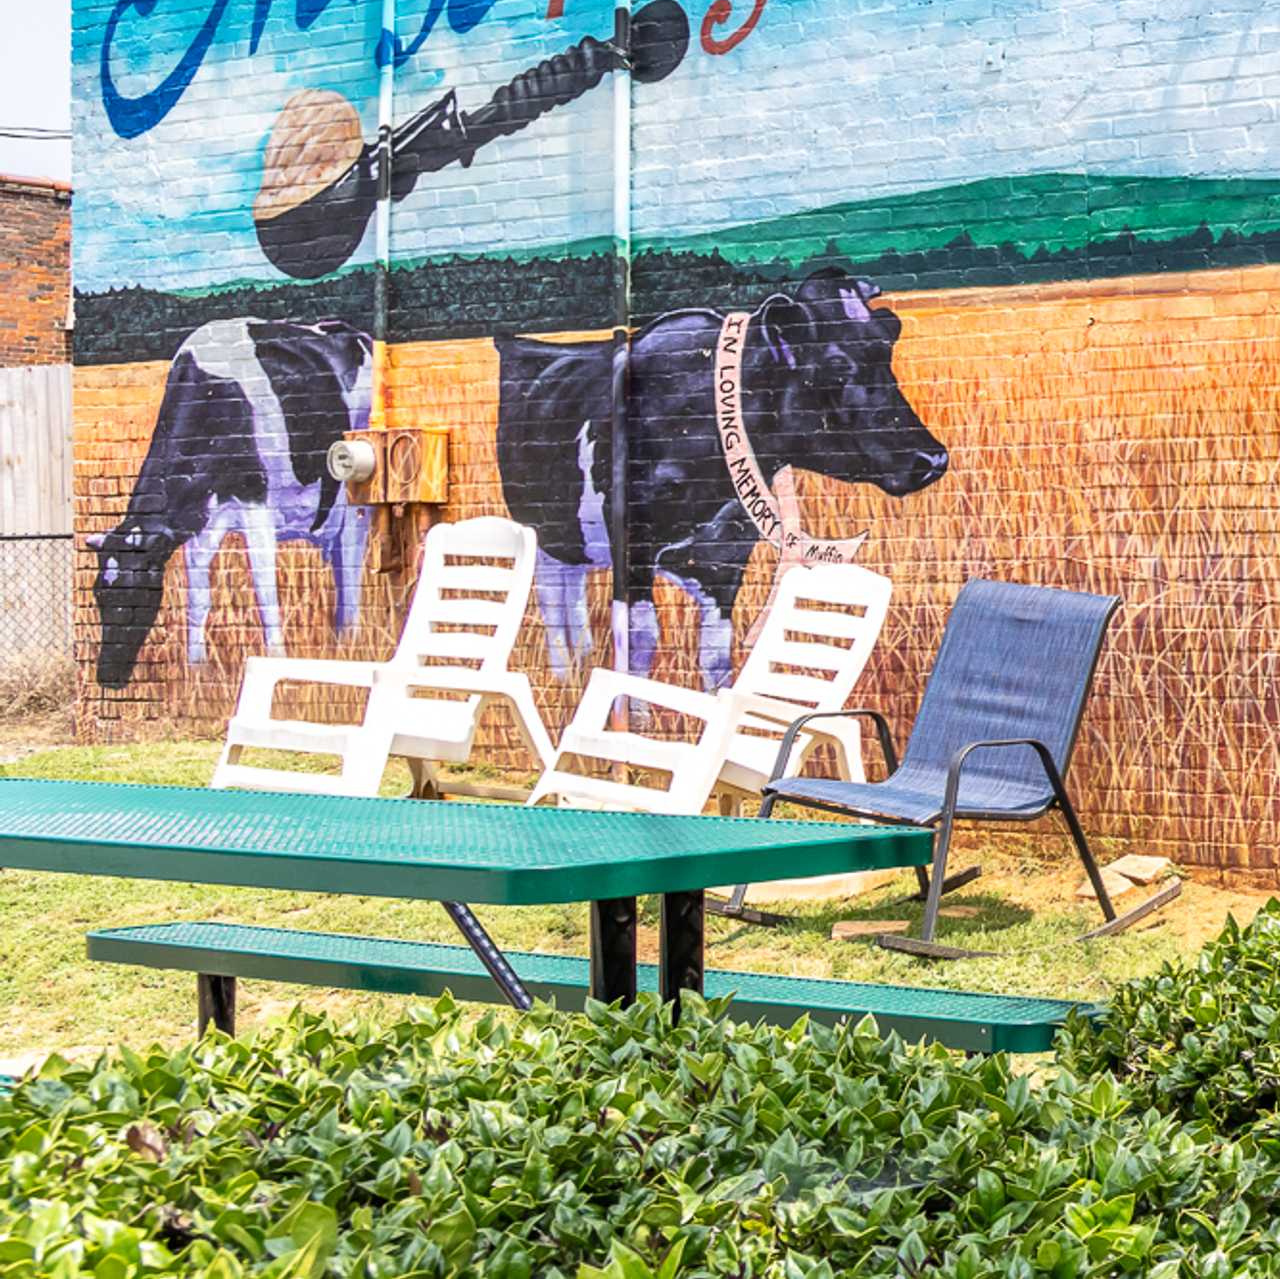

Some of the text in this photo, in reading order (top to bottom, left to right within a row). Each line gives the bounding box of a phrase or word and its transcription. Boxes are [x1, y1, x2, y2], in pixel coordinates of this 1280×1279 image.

[723, 318, 743, 354] IN
[720, 365, 741, 450] LOVING
[730, 457, 781, 536] MEMORY
